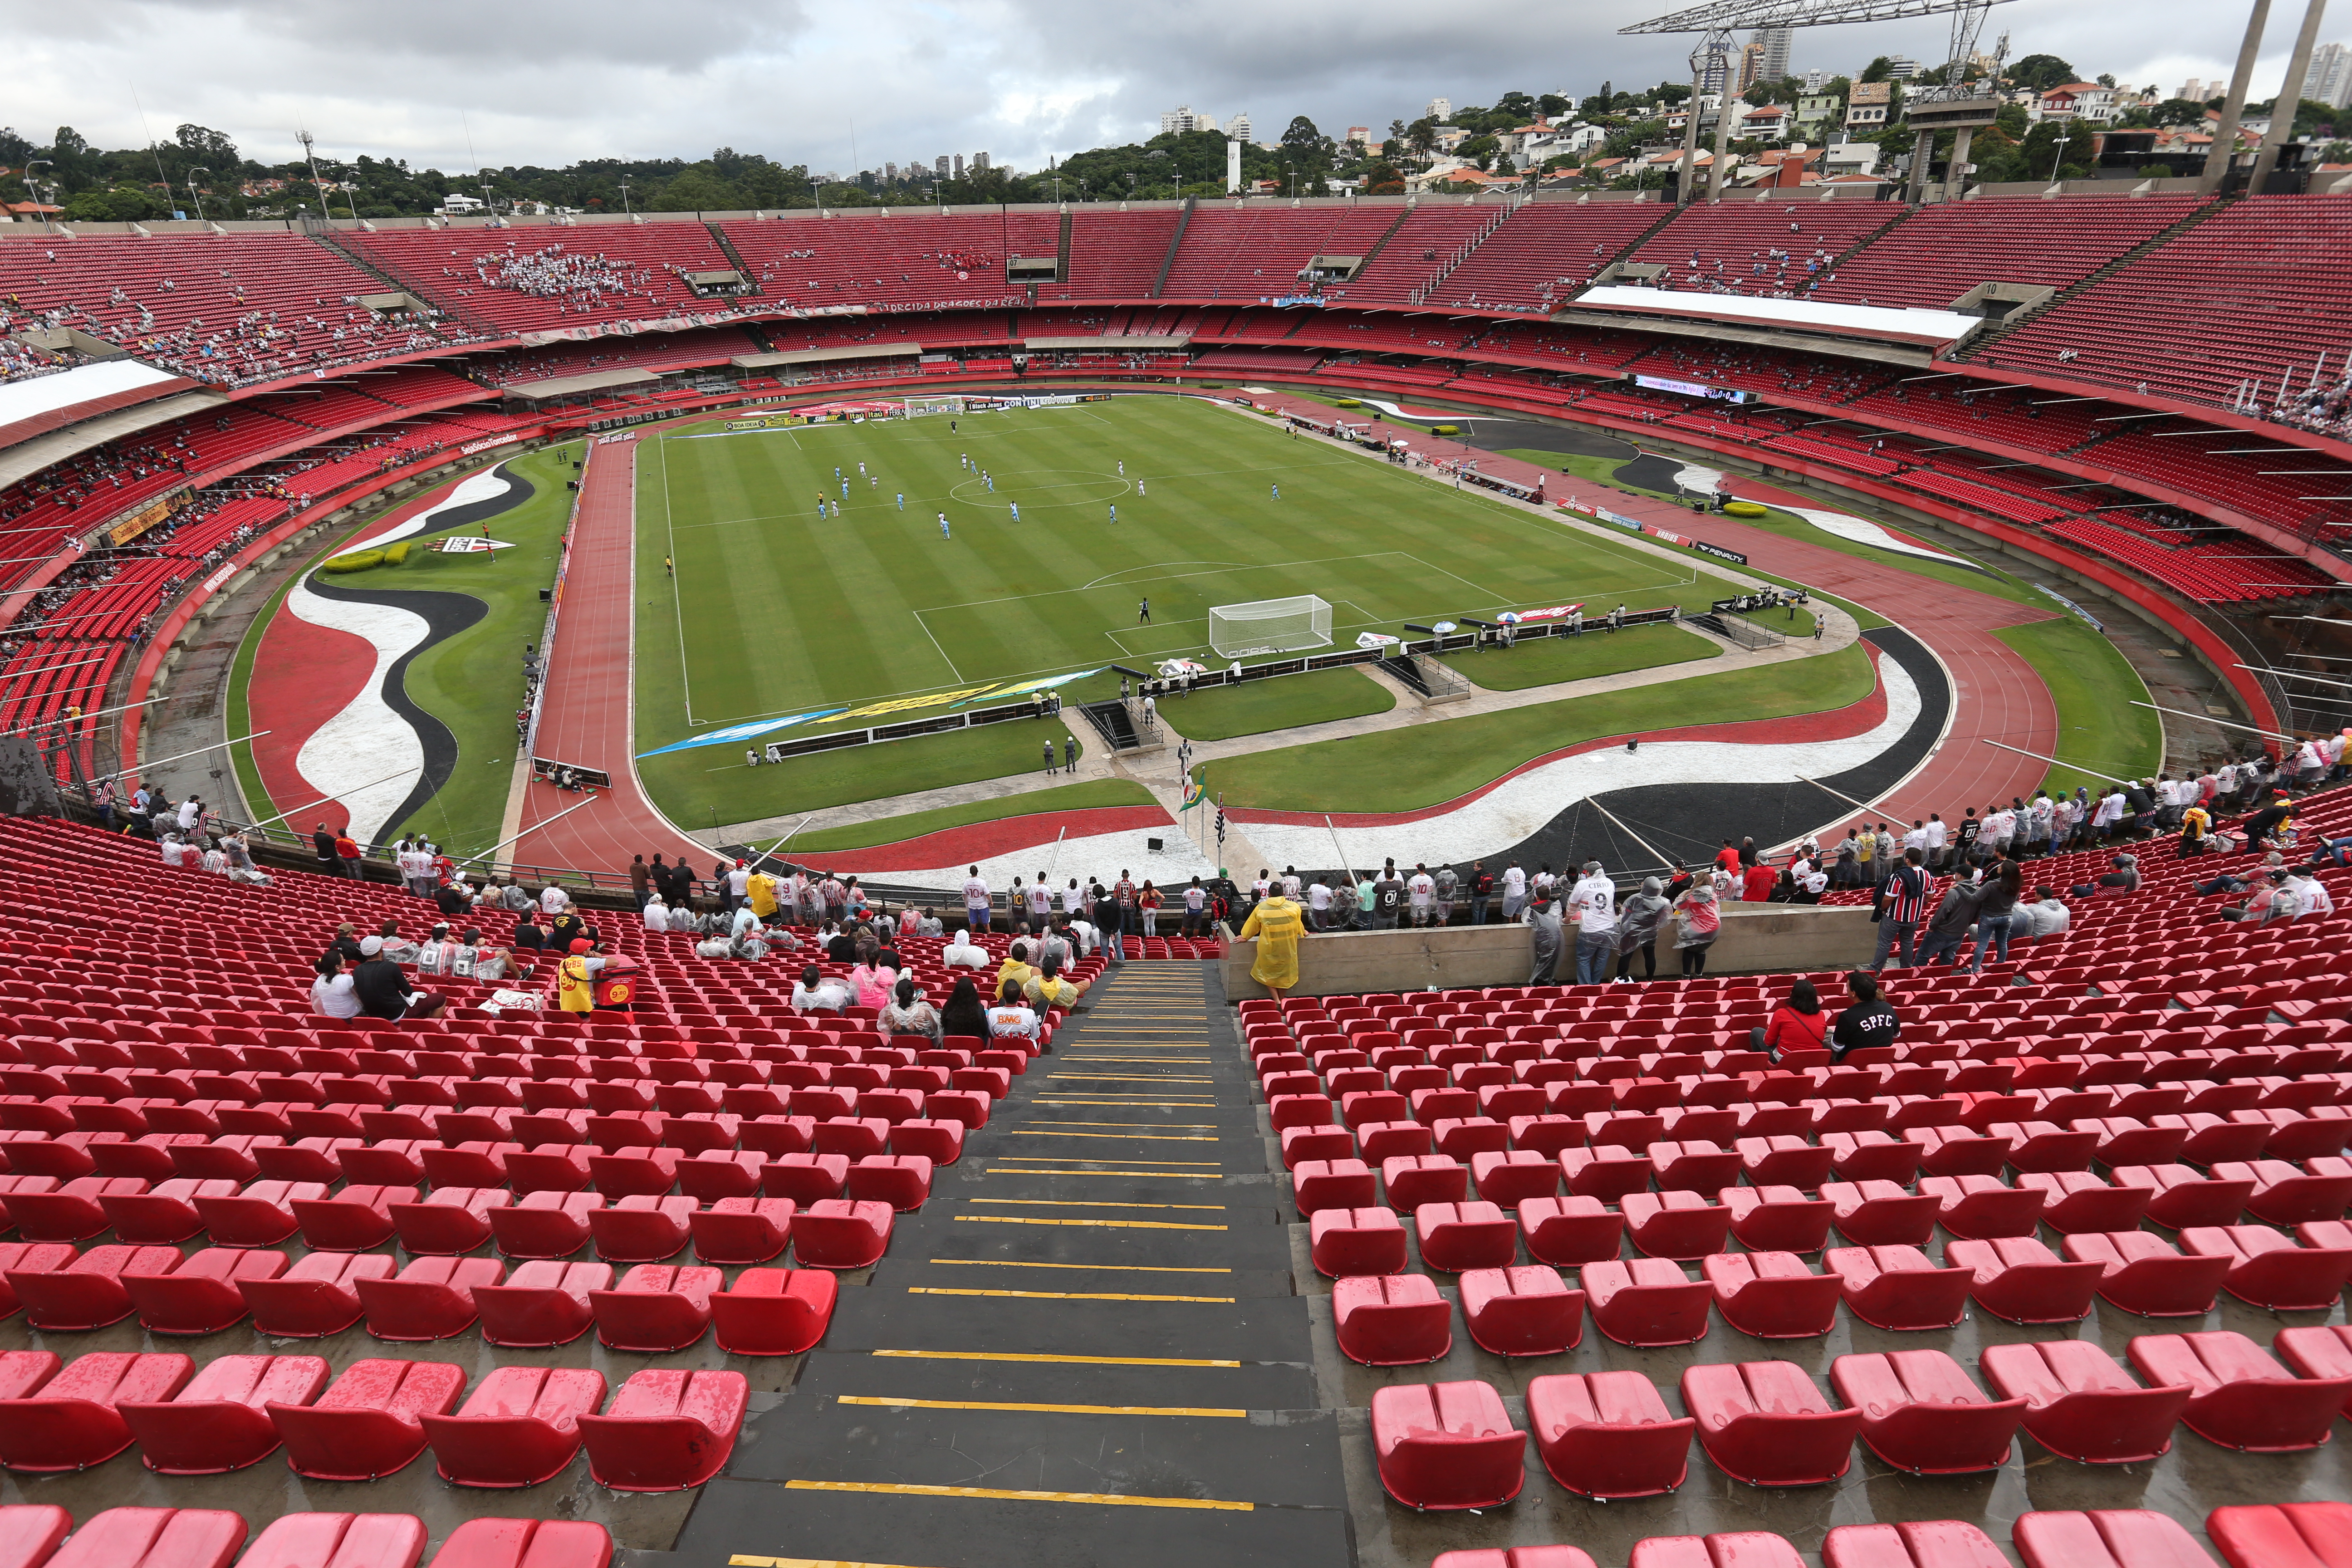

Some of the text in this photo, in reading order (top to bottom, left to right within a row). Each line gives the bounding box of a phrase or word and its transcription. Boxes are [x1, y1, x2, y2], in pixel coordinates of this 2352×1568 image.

[1987, 283, 1996, 294] 10
[884, 302, 931, 312] TORCIDA
[1000, 299, 1025, 307] REAL
[598, 435, 610, 445] DOLLY
[611, 433, 622, 443] DOLLY
[623, 431, 635, 440] DOLLY
[450, 538, 469, 551] SPFC
[1709, 548, 1743, 563] PENALTY
[783, 883, 790, 894] 9
[1417, 884, 1427, 894] 10
[1757, 877, 1771, 891] 10
[969, 888, 979, 898] 10
[1122, 889, 1128, 898] 9
[547, 894, 554, 904] 9
[1014, 894, 1023, 905] 10
[1595, 892, 1607, 910] 9
[562, 976, 575, 988] 94
[998, 1014, 1021, 1024] BMG
[1860, 1014, 1892, 1031] SPFC
